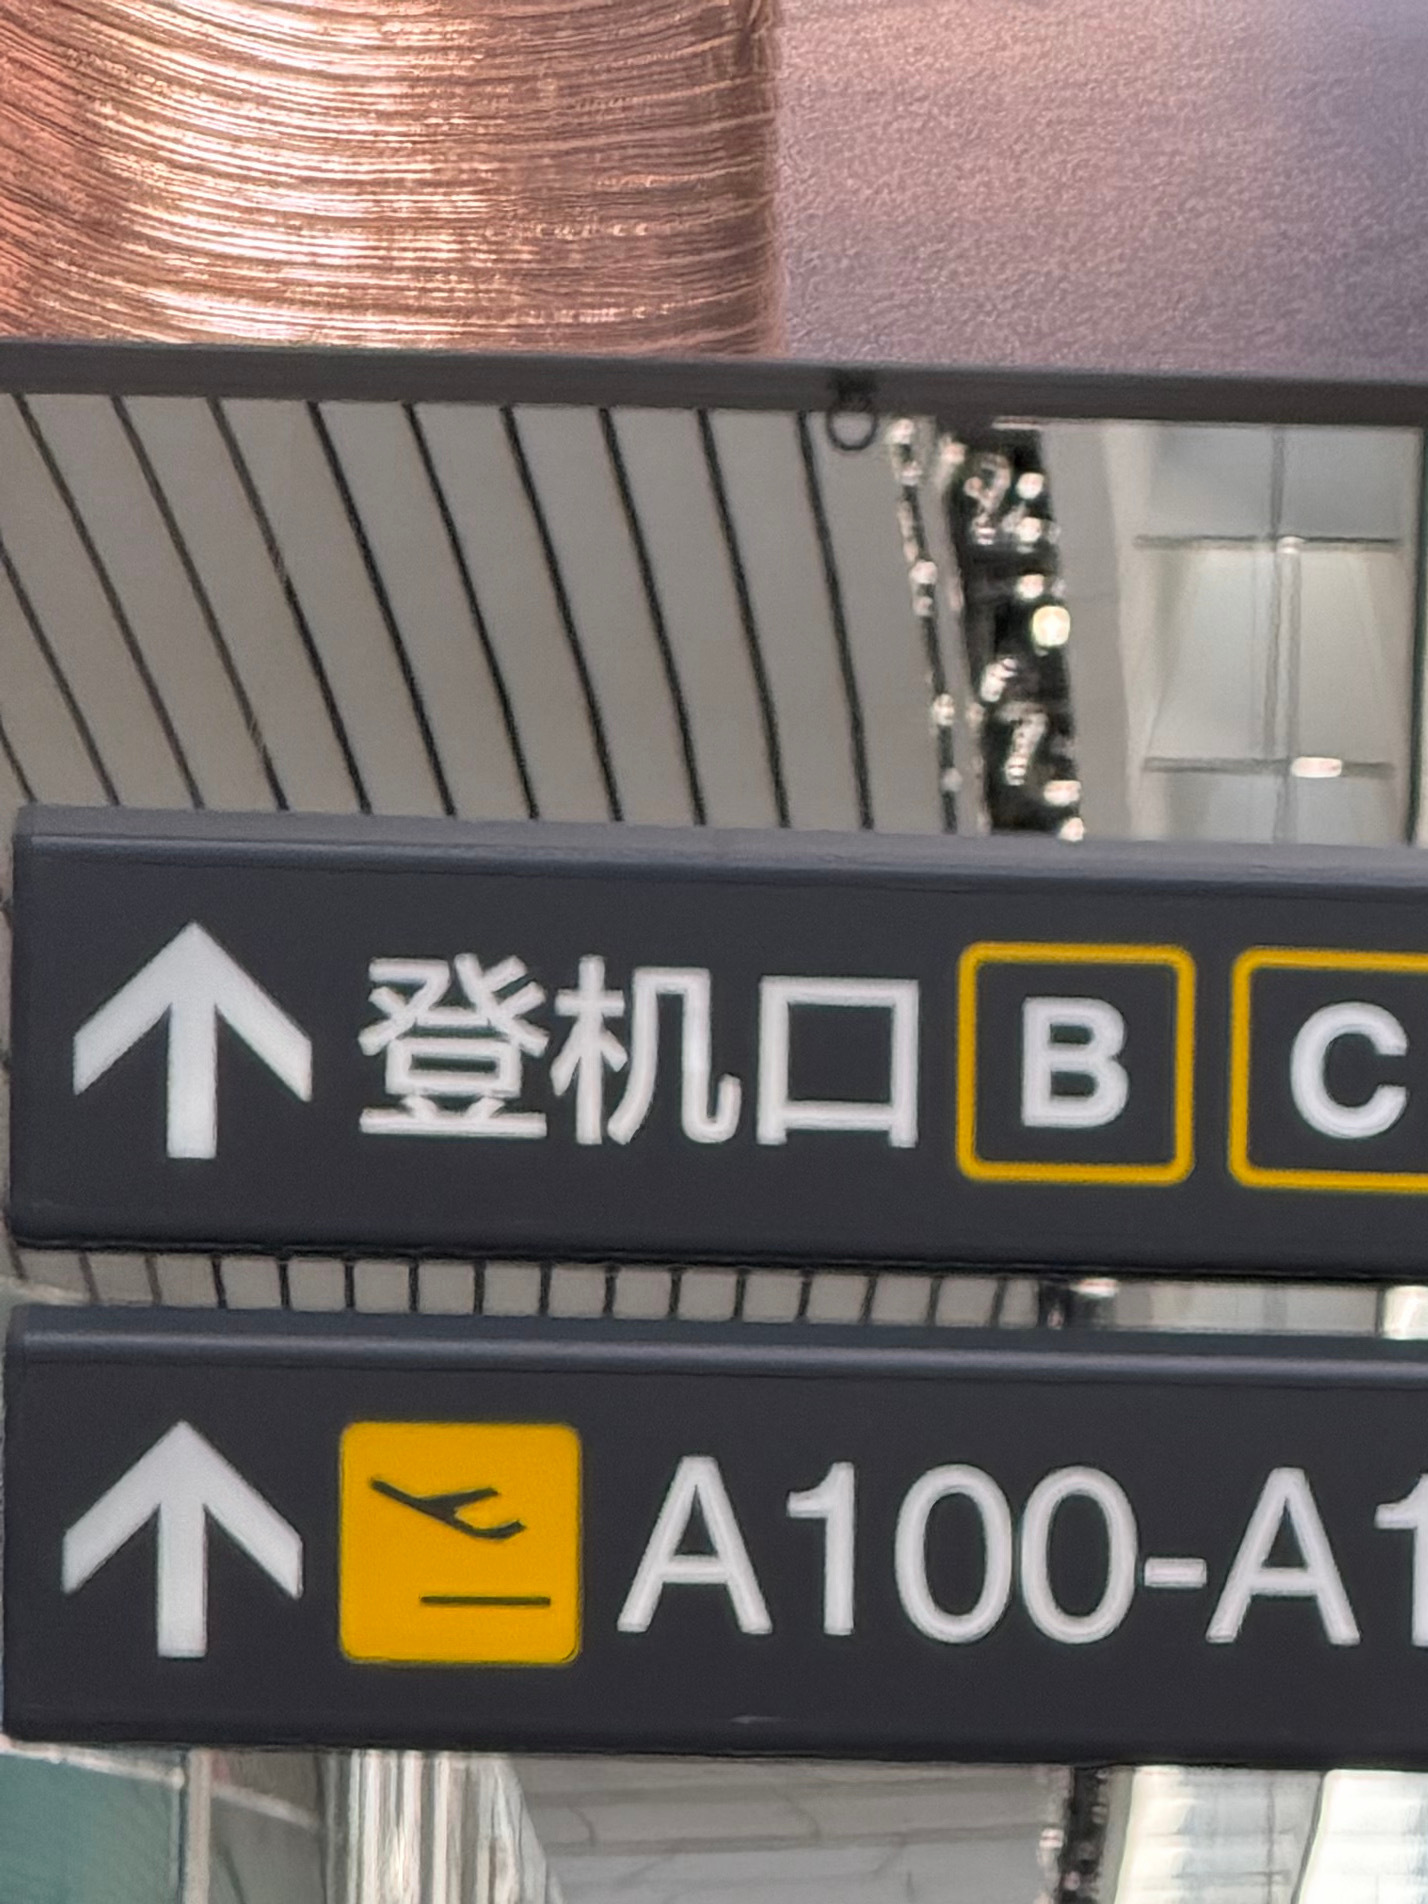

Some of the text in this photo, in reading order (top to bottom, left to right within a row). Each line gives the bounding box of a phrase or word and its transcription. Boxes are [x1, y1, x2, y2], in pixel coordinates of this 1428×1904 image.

[359, 954, 918, 1147] 登机口
[1022, 998, 1127, 1128] B
[1291, 1003, 1407, 1138] C
